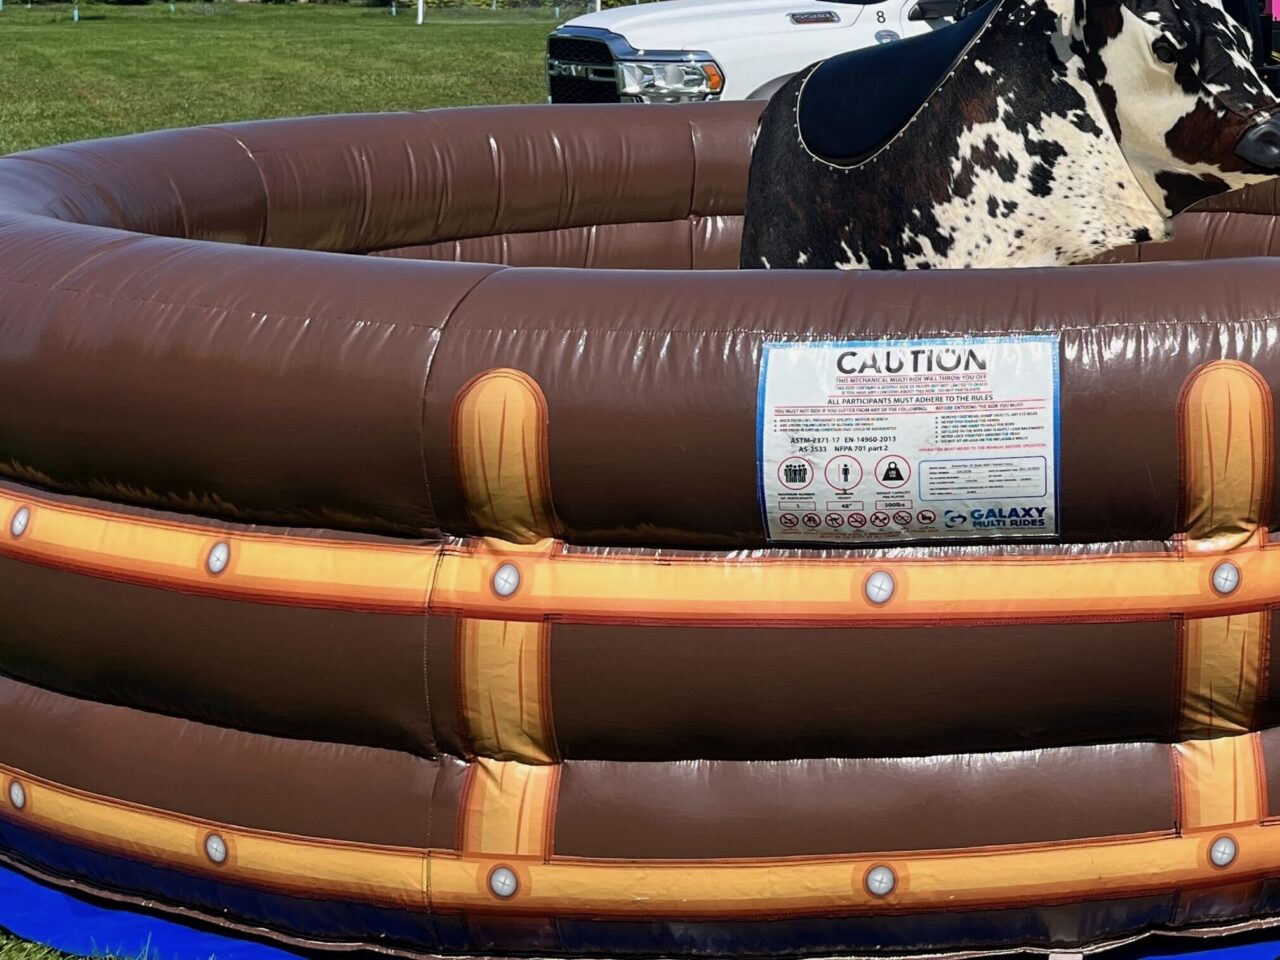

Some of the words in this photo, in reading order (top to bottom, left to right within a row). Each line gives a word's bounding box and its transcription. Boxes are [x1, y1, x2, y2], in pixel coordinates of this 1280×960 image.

[876, 10, 886, 24] 8
[836, 348, 988, 375] CAUTION
[841, 397, 892, 405] PARTICIPANTS
[970, 507, 1047, 520] GALAXY
[973, 519, 1006, 528] MULTI
[1010, 518, 1045, 527] RIDES
